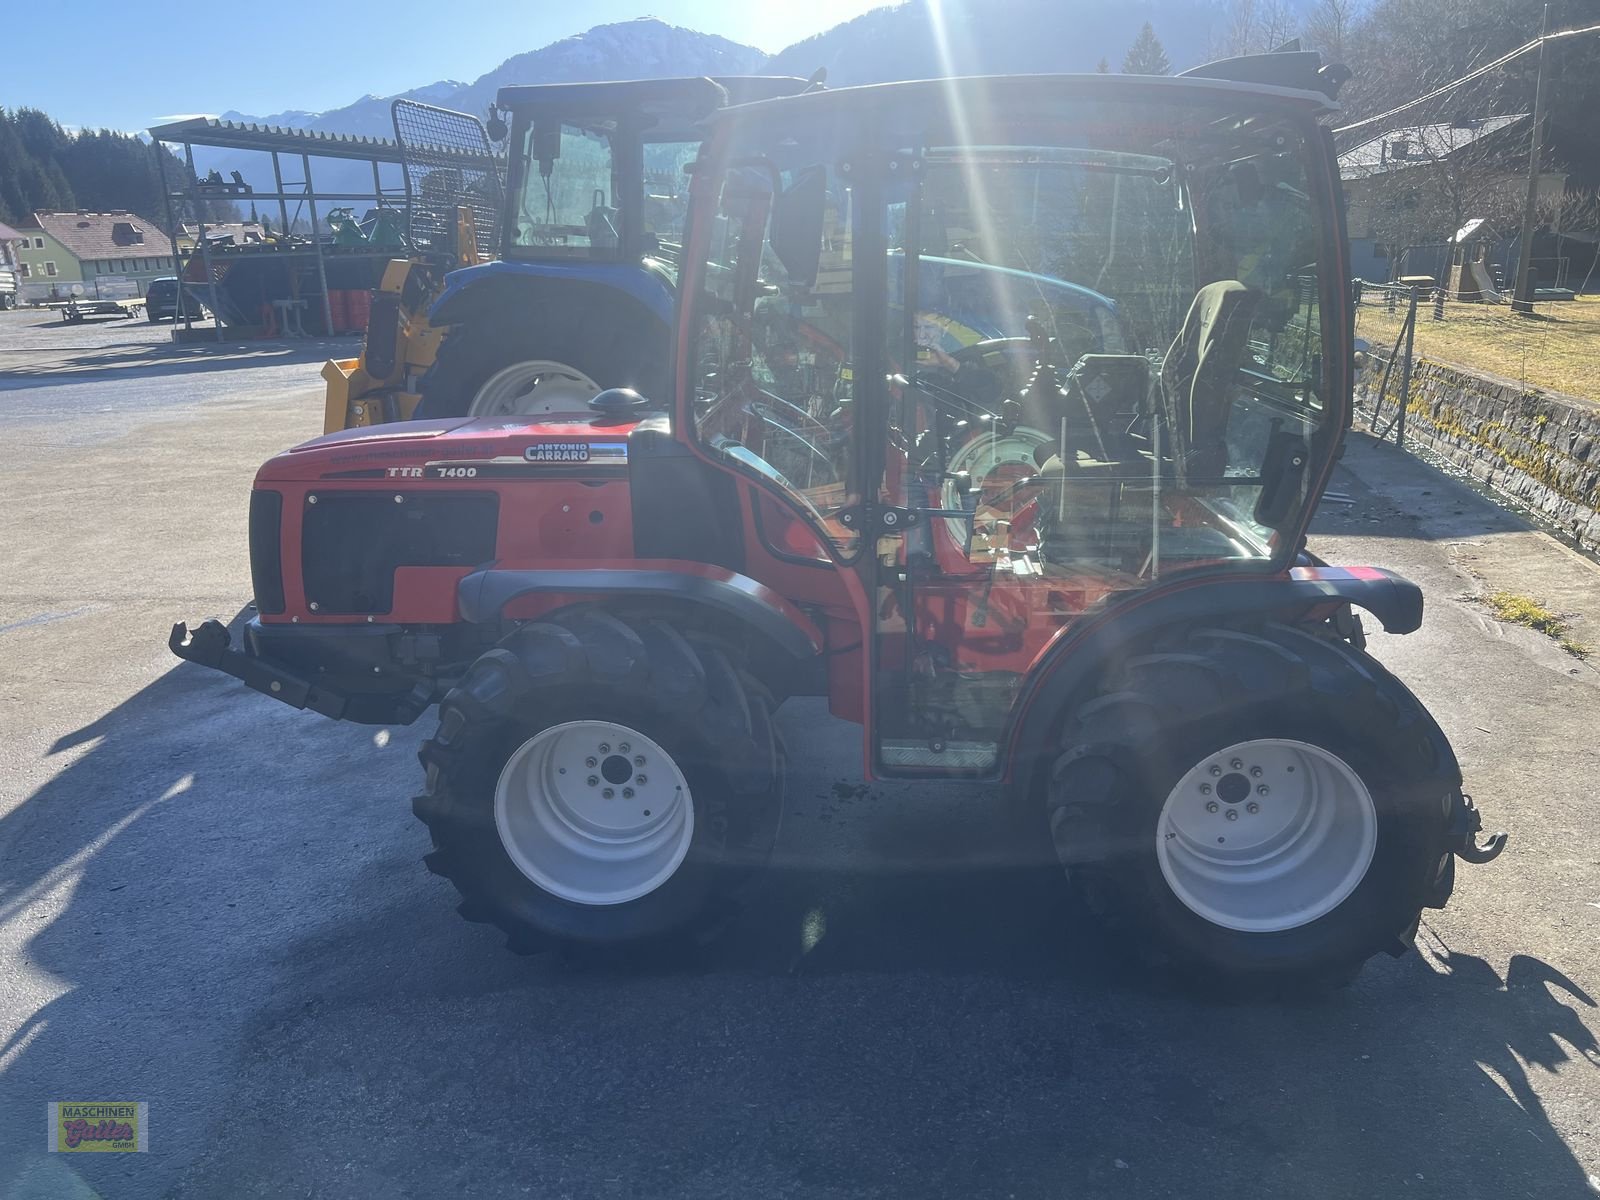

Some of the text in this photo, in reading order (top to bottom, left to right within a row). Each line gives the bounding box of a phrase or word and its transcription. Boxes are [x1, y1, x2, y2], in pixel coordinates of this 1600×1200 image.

[537, 443, 588, 451] ANTONIO
[525, 446, 589, 461] CARRARO
[387, 467, 477, 478] TTR 7400
